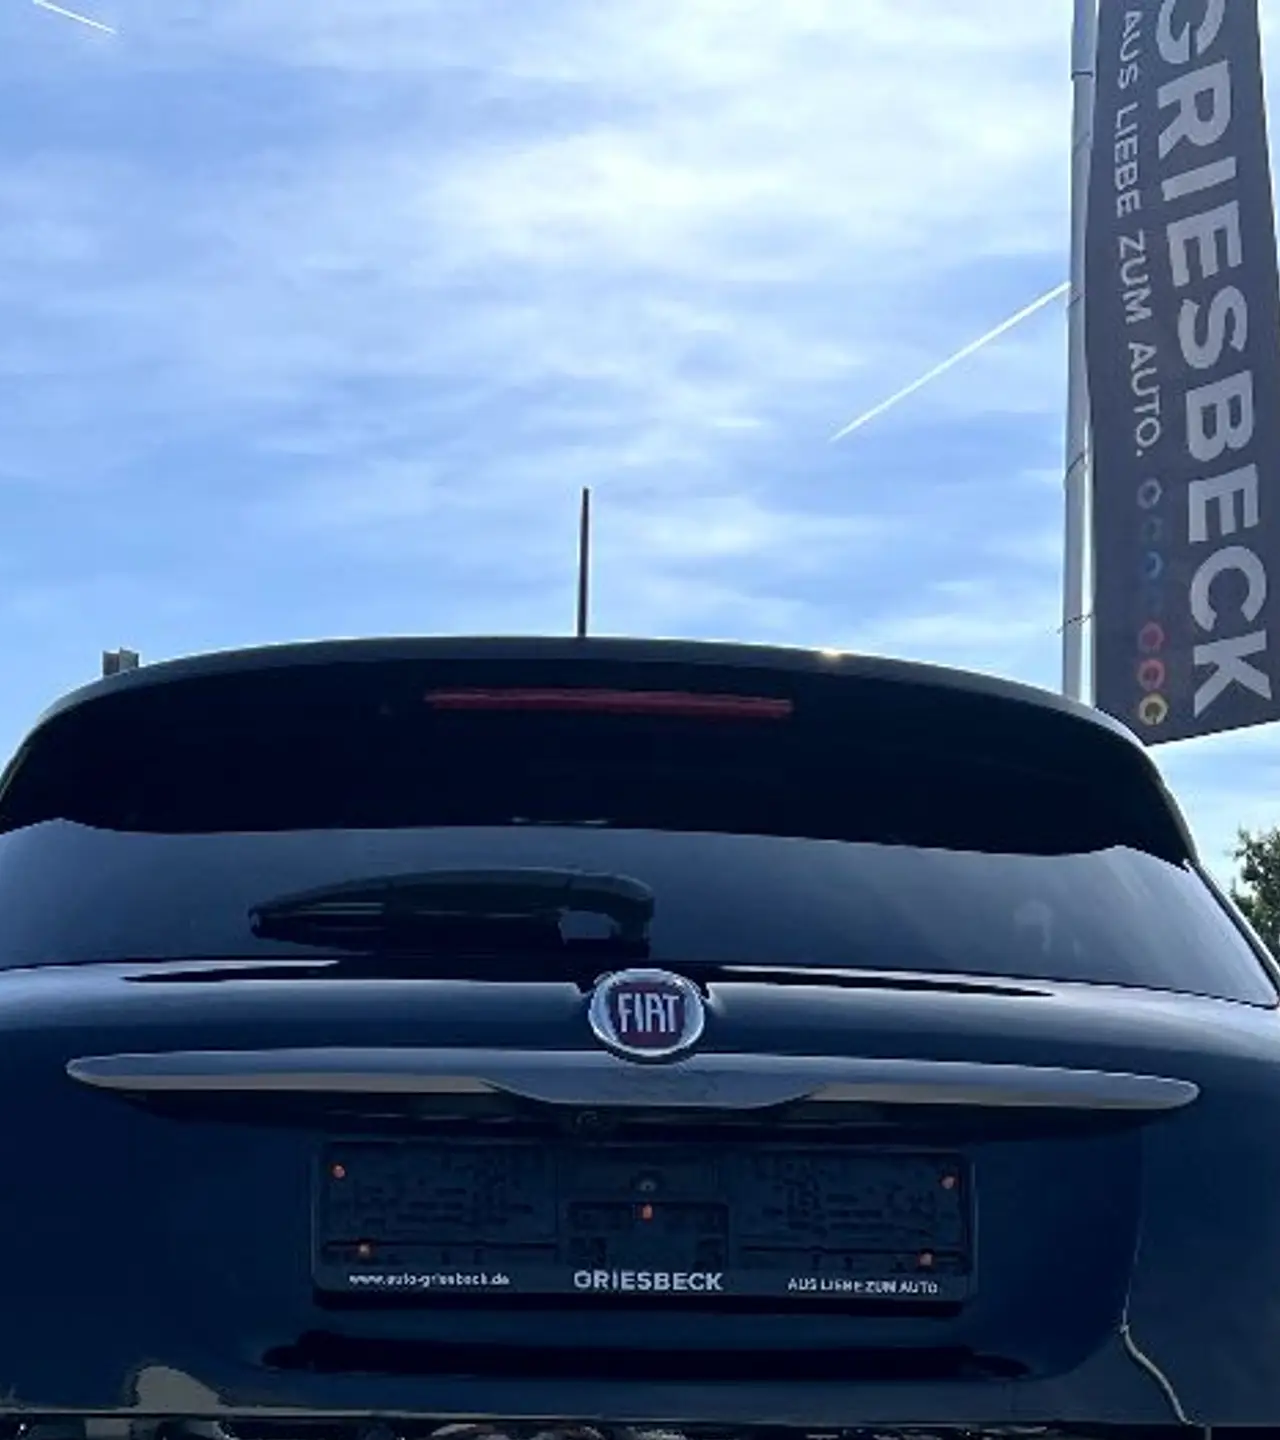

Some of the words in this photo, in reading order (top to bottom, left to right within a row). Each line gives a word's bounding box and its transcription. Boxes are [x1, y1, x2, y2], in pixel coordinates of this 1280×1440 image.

[1117, 10, 1143, 89] AUS
[1114, 102, 1142, 218] LIEBE
[1118, 228, 1153, 325] ZUM
[1128, 341, 1161, 457] AUTO.
[1156, 0, 1272, 718] GRIESBECK
[618, 992, 680, 1034] FIAT
[573, 1269, 724, 1291] GRIESBECK
[787, 1277, 818, 1291] AUS
